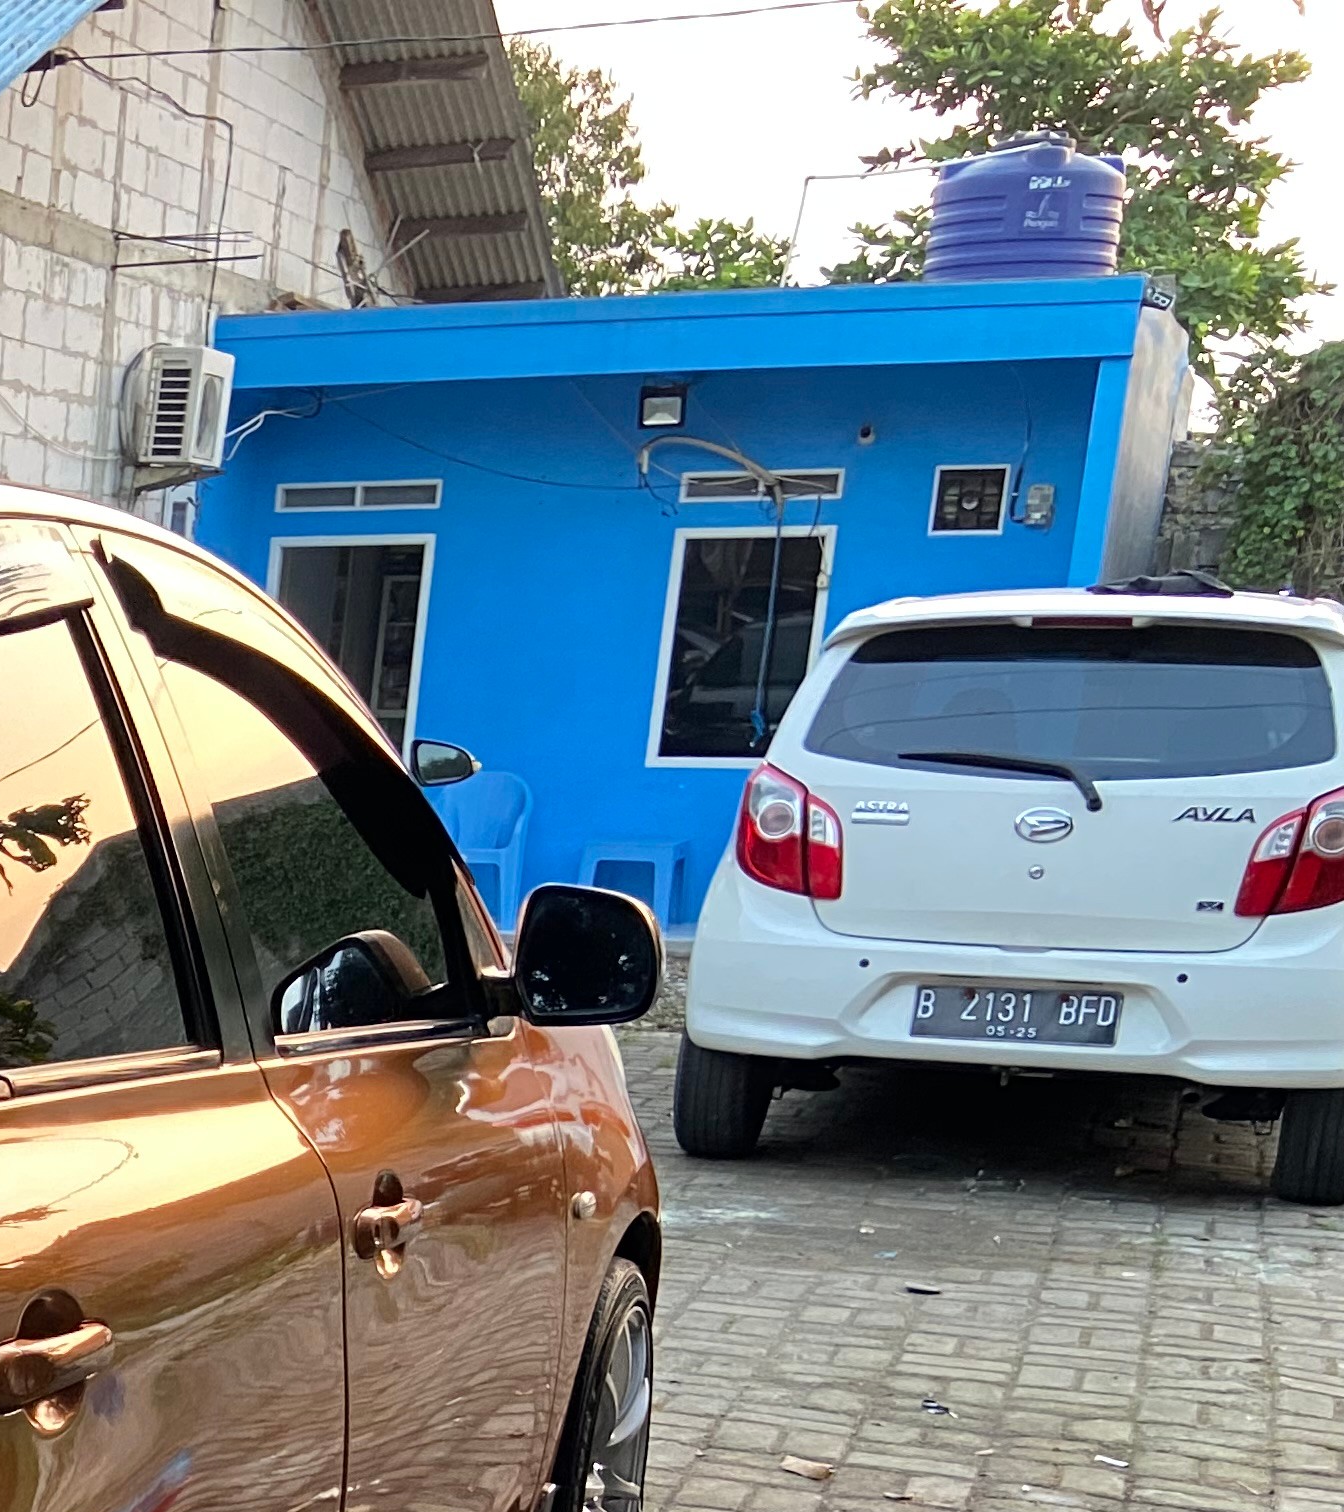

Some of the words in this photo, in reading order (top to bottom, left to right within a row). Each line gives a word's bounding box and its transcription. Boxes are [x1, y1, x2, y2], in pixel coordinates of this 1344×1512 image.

[854, 800, 910, 813] ASTRA
[916, 989, 936, 1019] B
[960, 991, 1033, 1023] 2131
[1059, 995, 1117, 1027] BFD
